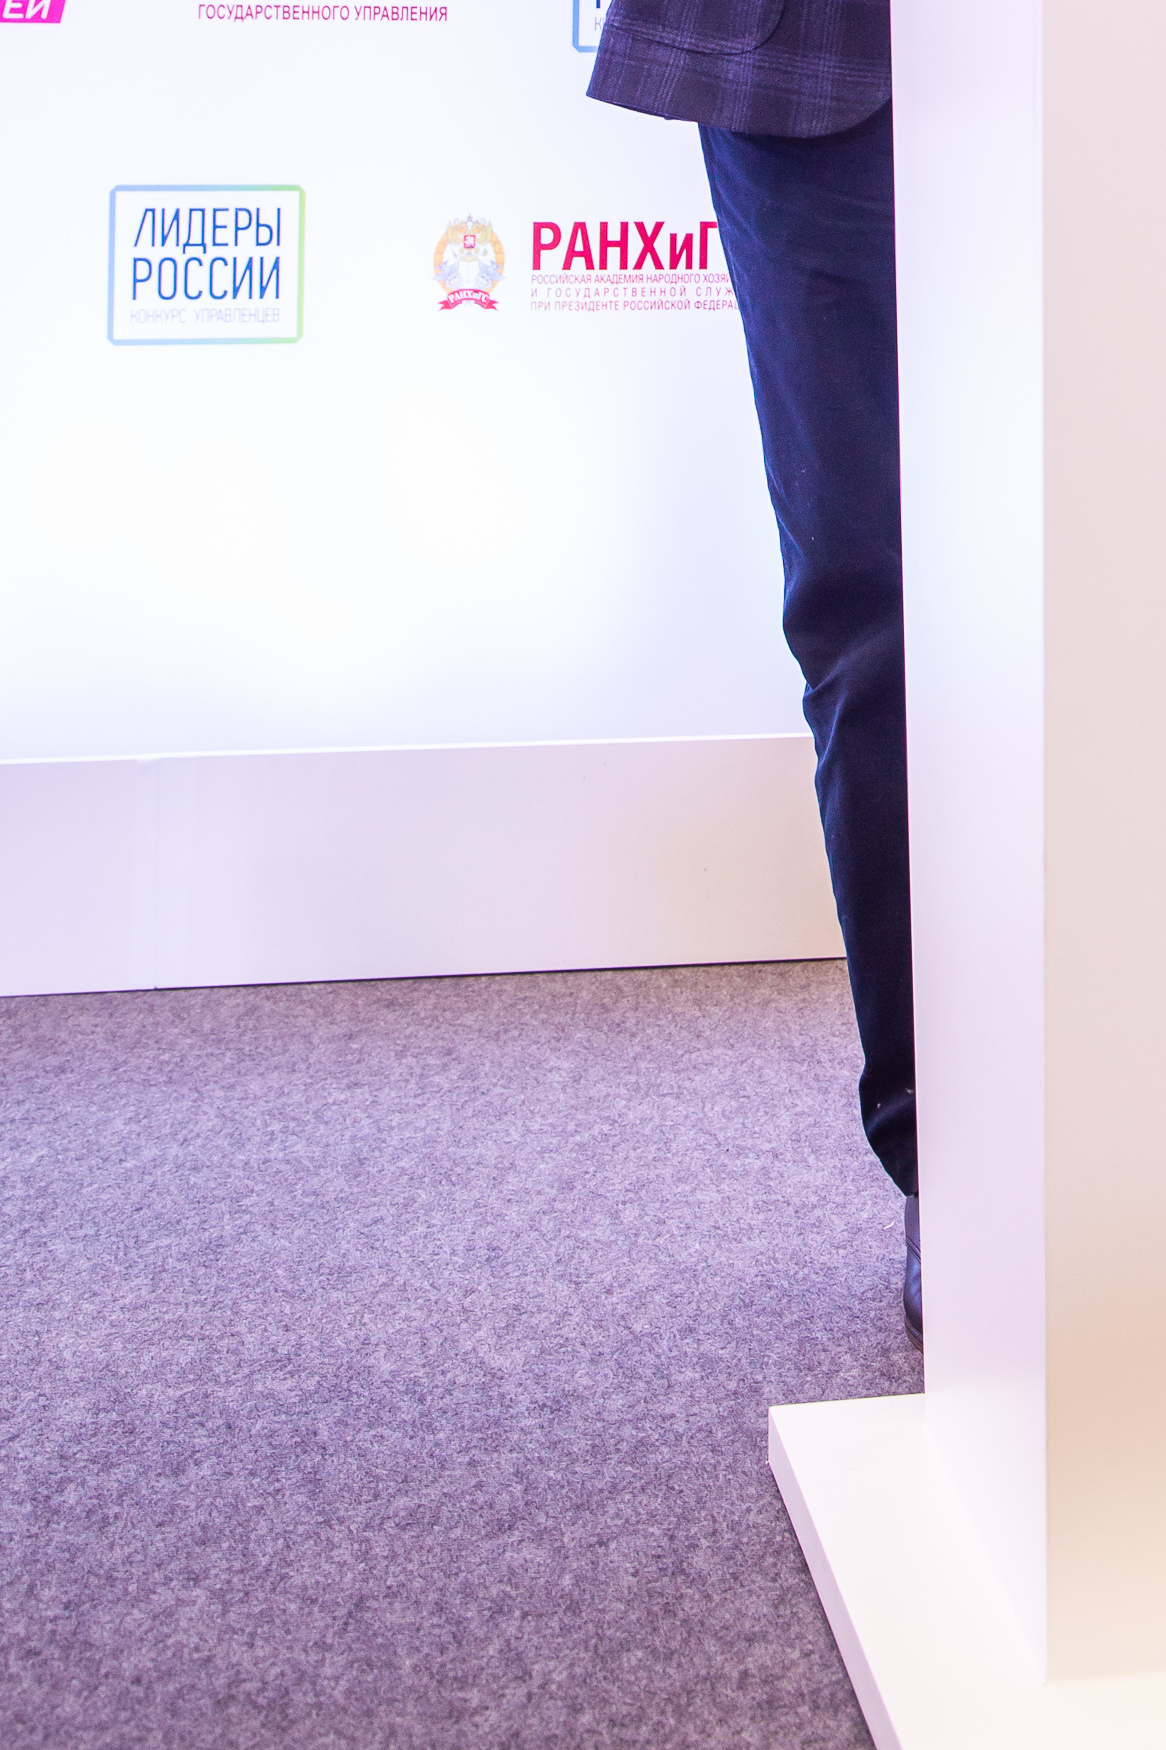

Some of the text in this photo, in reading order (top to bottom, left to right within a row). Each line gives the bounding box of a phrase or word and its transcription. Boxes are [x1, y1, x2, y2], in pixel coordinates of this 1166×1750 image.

[198, 4, 448, 22] ГОСУДАРСТВЕННОГО УПРАВЛЕНИЯ
[134, 207, 281, 254] ЛИДЕРЫ
[532, 221, 718, 271] РАНХиГ
[132, 256, 280, 301] РОССИИ
[531, 273, 592, 284] РОССИЙСКАЯ
[594, 273, 644, 285] АКАДЕМИЯ
[646, 273, 700, 284] НАРОДНОГО
[695, 286, 734, 297] СЛУЖ
[554, 301, 620, 312] ПРЕЗИДЕНТЕ
[622, 299, 691, 311] РОССИЙСКОЙ
